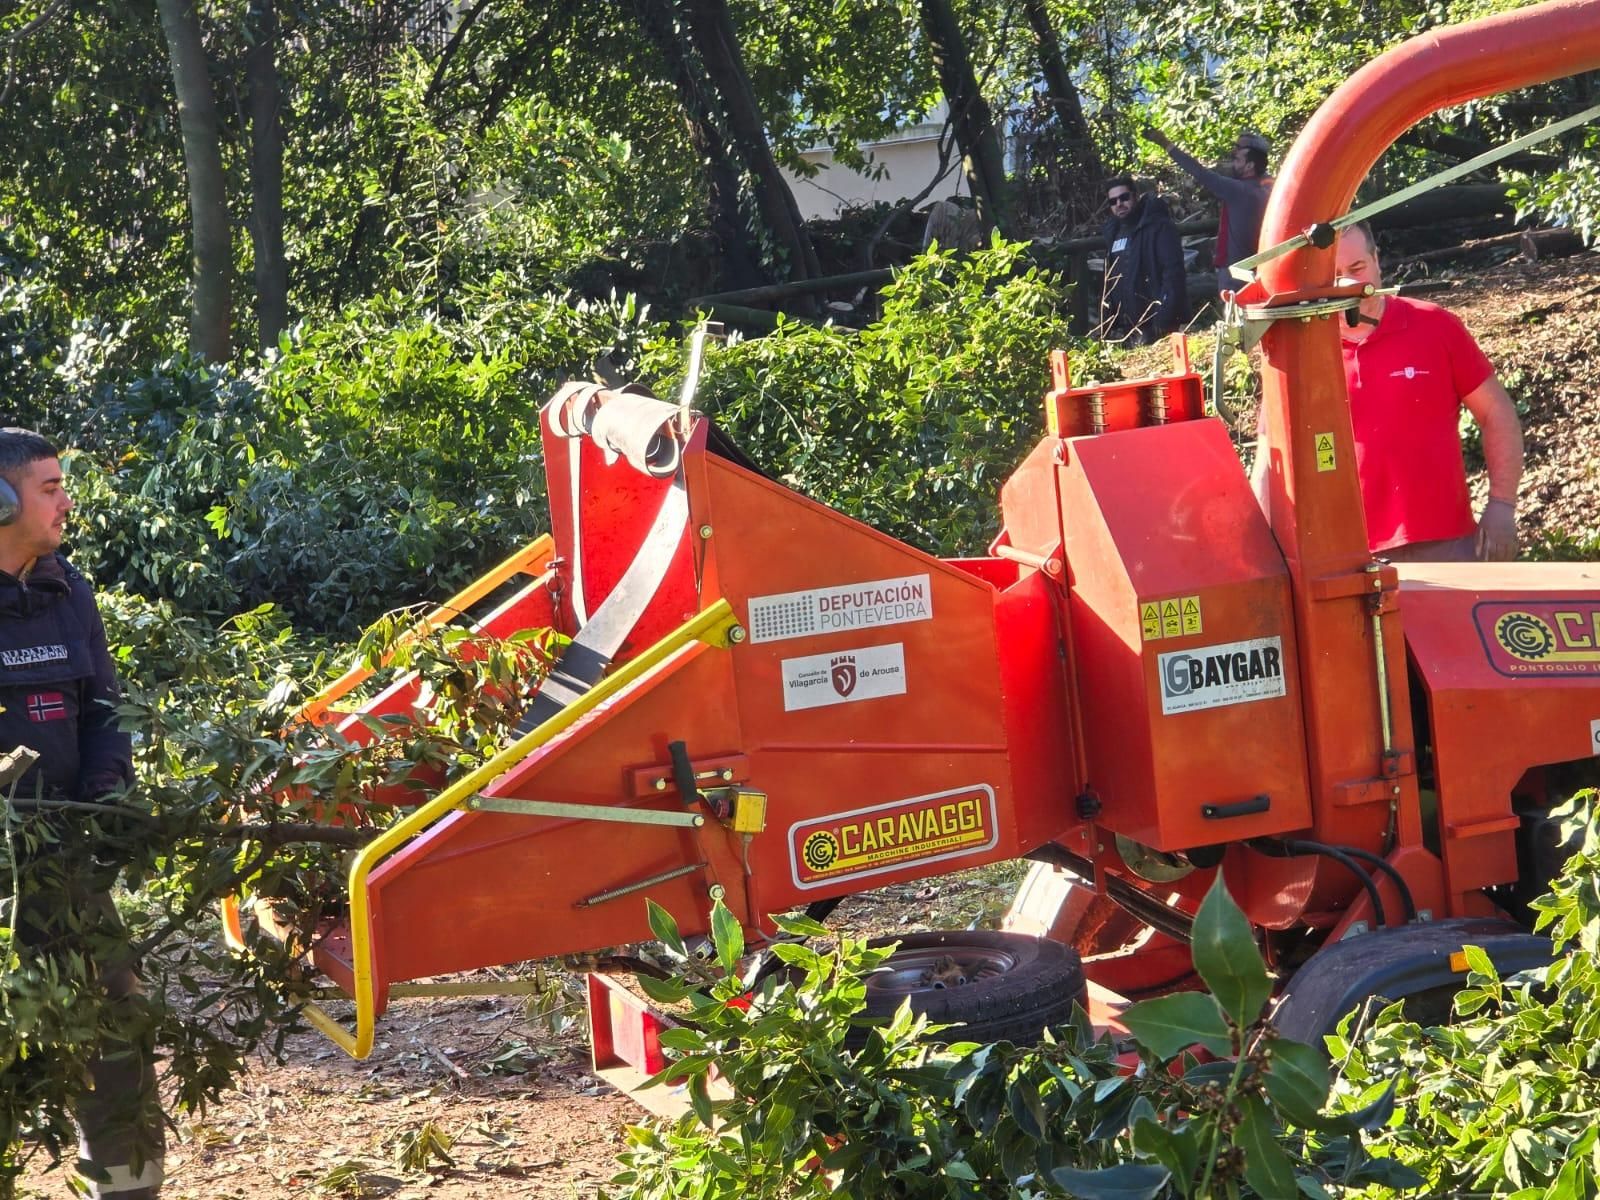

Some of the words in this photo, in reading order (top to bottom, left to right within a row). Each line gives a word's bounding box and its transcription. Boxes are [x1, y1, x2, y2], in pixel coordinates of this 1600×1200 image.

[819, 581, 924, 613] DEPUTACIÓN
[820, 601, 928, 630] PONTEVEDRA
[1554, 612, 1600, 648] C
[859, 669, 870, 678] de
[871, 666, 900, 676] Arousa
[1509, 663, 1587, 672] PONTOGLIO
[841, 798, 983, 856] CARAVAGGI
[867, 847, 910, 861] MACCHINE
[911, 835, 963, 852] INDUSTRIALI
